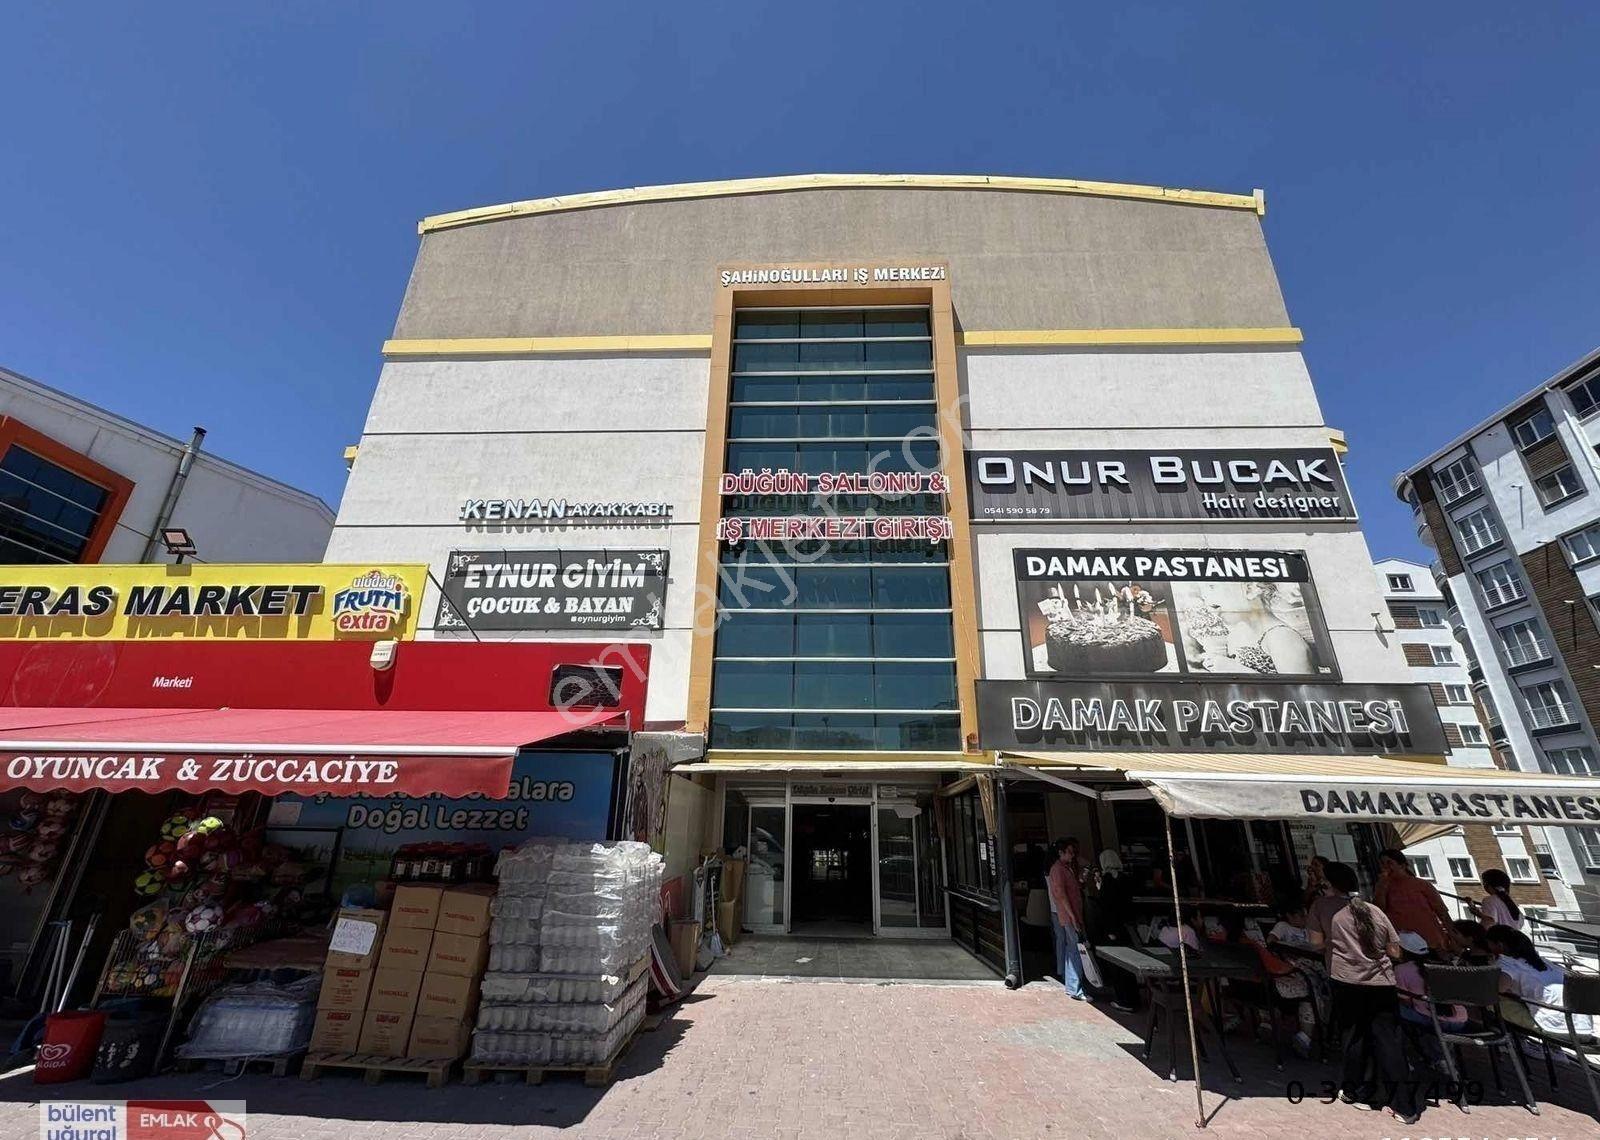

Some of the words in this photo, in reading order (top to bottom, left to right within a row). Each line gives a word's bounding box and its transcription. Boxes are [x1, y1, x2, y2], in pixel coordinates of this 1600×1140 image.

[721, 268, 848, 287] ŞAHİNOĞULLARI
[853, 267, 869, 285] İŞ
[874, 266, 946, 281] MERKEZİ
[722, 468, 808, 495] DÜĞÜN
[818, 472, 921, 494] SALONU
[929, 472, 947, 493] &
[977, 456, 1130, 486] ONUR
[1149, 456, 1335, 484] BUCAK
[463, 498, 567, 519] KENAN
[572, 503, 668, 517] AYAKKABI
[1202, 491, 1246, 509] Hair
[1254, 491, 1340, 512] designer
[718, 517, 743, 545] İŞ
[750, 517, 867, 539] MERKEZİ
[873, 516, 950, 544] GİRİŞİ
[463, 563, 558, 588] EYNUR
[561, 559, 646, 588] GİYİM
[1026, 556, 1130, 578] DAMAK
[1136, 556, 1290, 578] PASTANESİ
[0, 585, 113, 616] ERAS
[124, 585, 324, 617] MARKET
[466, 597, 541, 619] ÇOCUK
[543, 597, 561, 614] &
[563, 596, 635, 614] BAYAN
[339, 611, 388, 630] extra
[152, 676, 194, 688] Marketi
[1011, 697, 1166, 733] DAMAK
[1173, 699, 1410, 735] PASTANESİ
[6, 756, 164, 781] OYUNCAK
[176, 761, 202, 781] &
[209, 754, 399, 785] ZÜCCACİYE
[1300, 789, 1424, 816] DAMAK
[347, 803, 430, 834] Doğal
[436, 805, 529, 832] Lezzet
